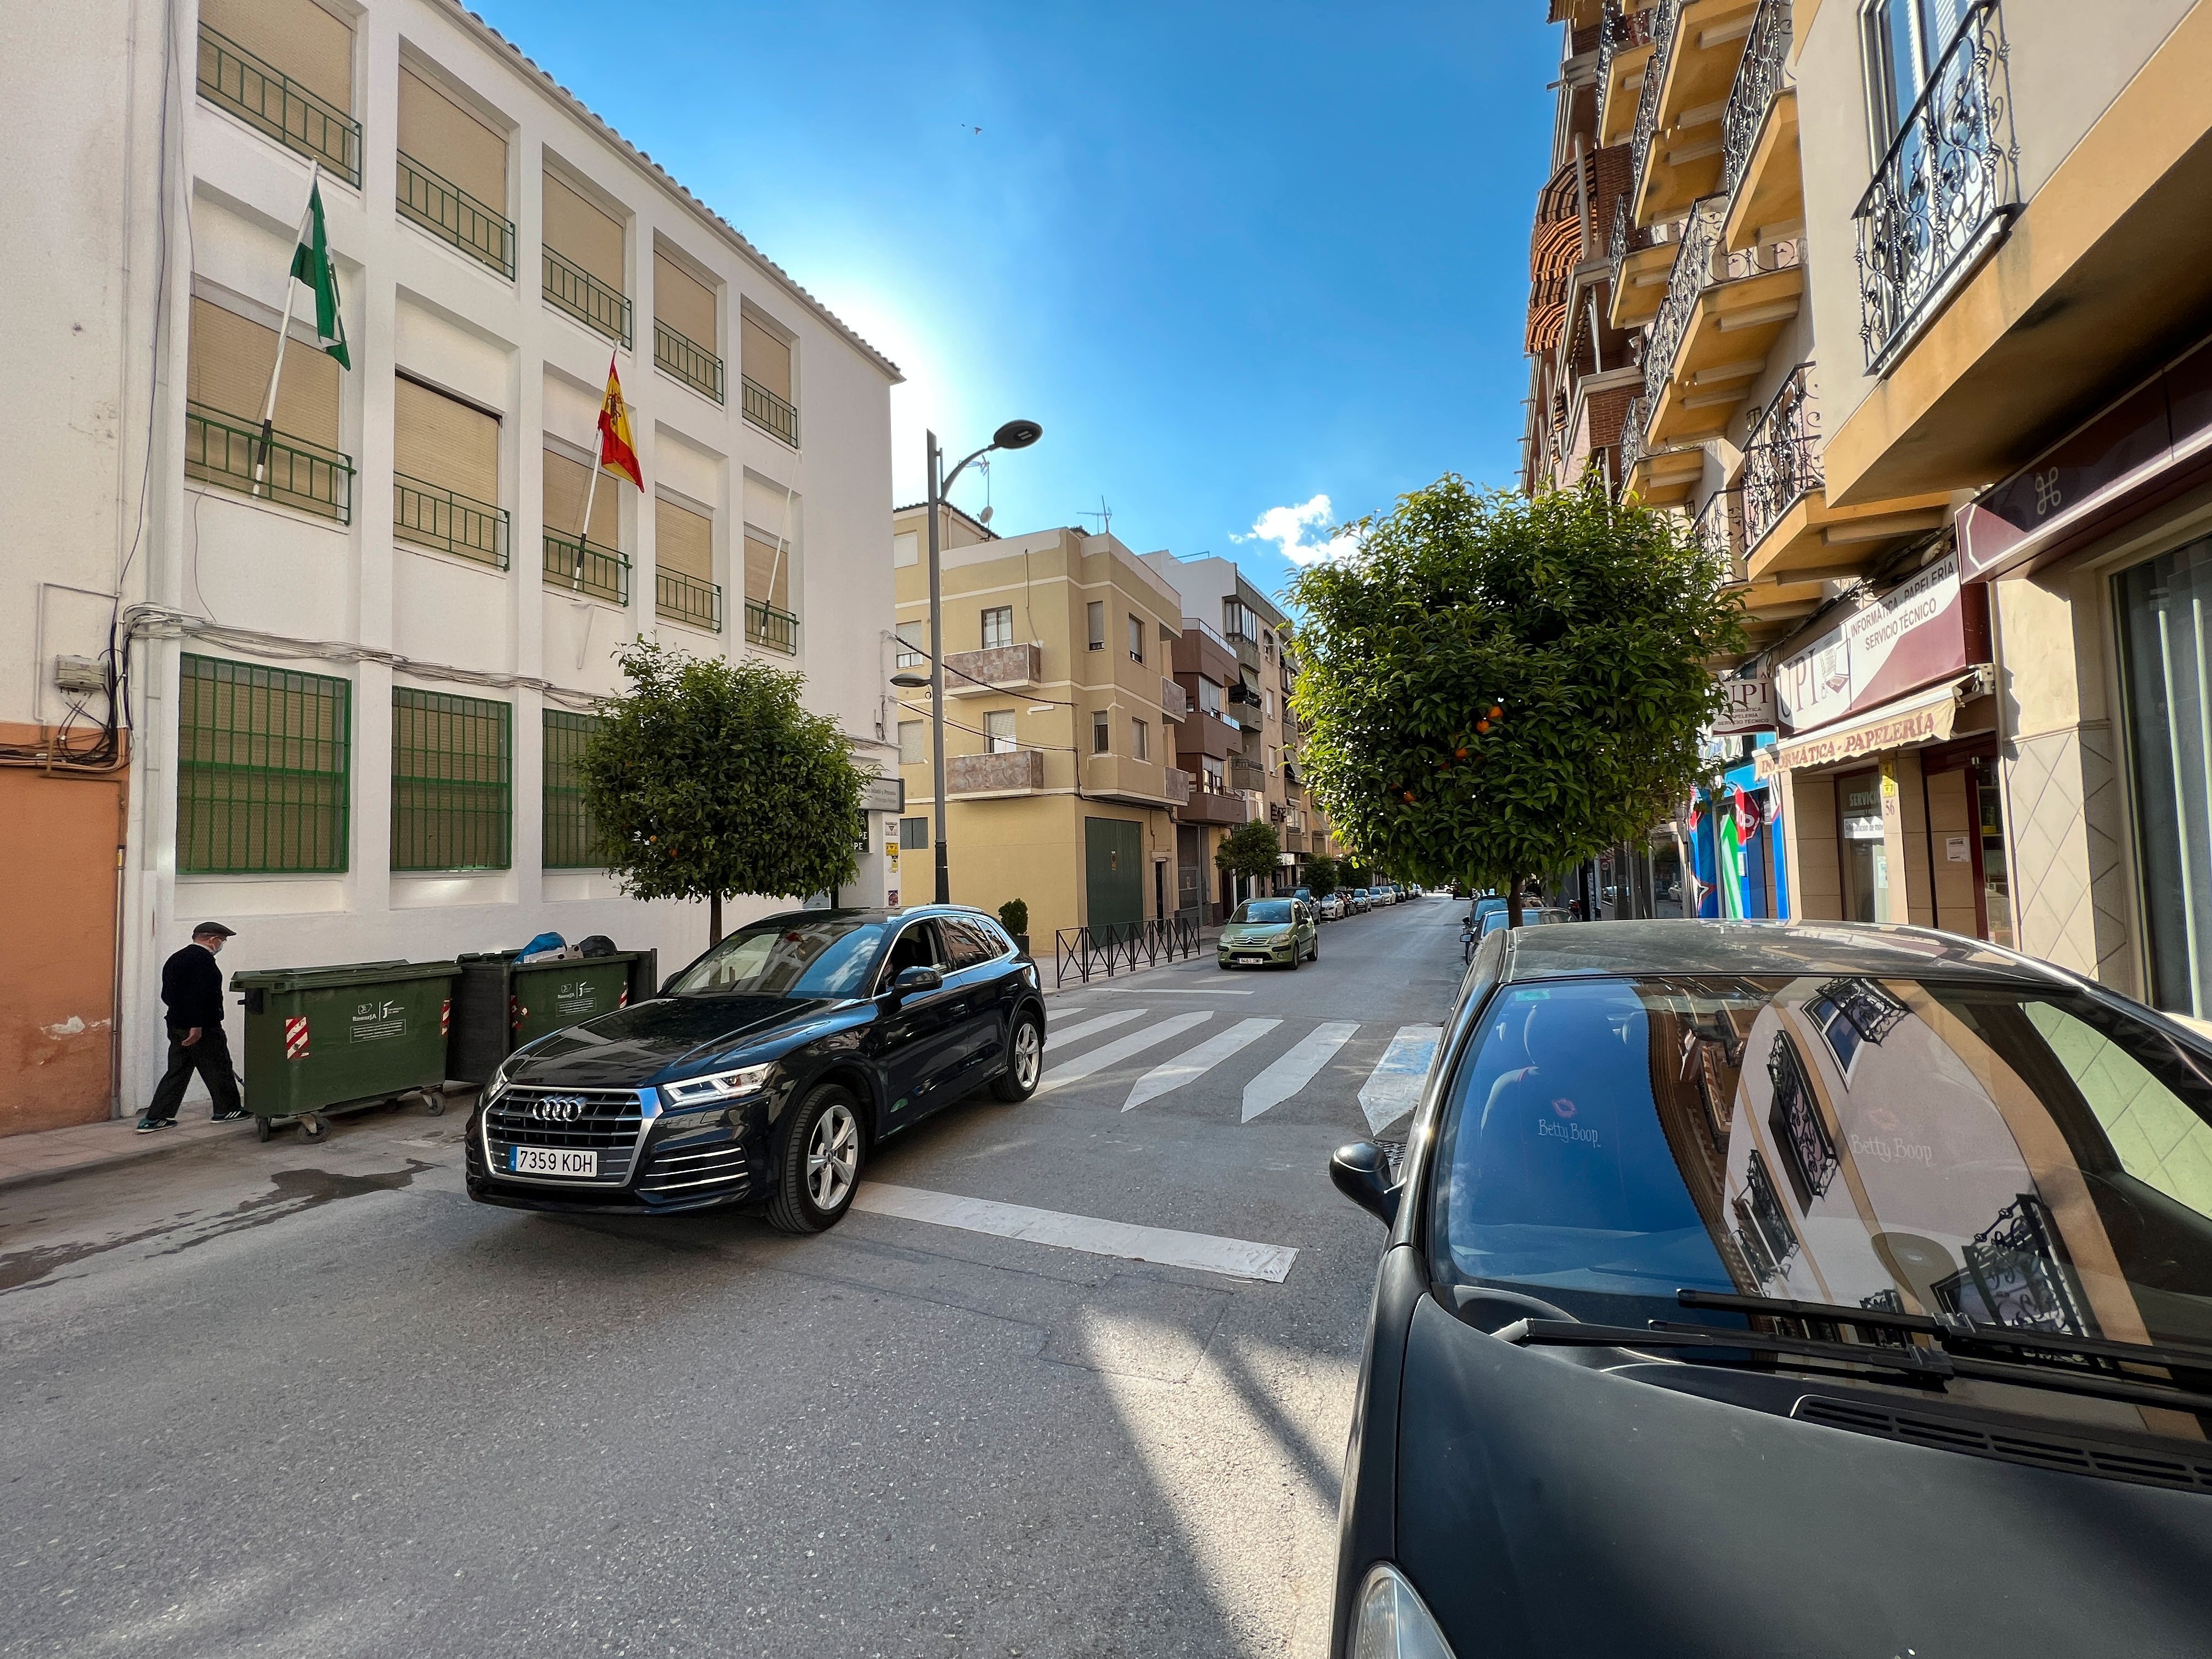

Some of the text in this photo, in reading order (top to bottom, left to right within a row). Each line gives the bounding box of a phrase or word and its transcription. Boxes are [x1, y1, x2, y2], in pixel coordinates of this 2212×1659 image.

[1851, 597, 1898, 637] INFORMÁTICA
[1904, 561, 1954, 604] PAPELERÍA
[1865, 597, 1937, 651] SERVICIO TÉCNICO
[1777, 648, 1819, 718] UPI
[1844, 713, 1934, 753] PAPELERÍA
[1886, 799, 1894, 816] 56
[1538, 1119, 1598, 1148] Betty Boop
[1850, 1134, 1932, 1167] Betty Boop
[520, 1151, 592, 1173] 7359 KDH
